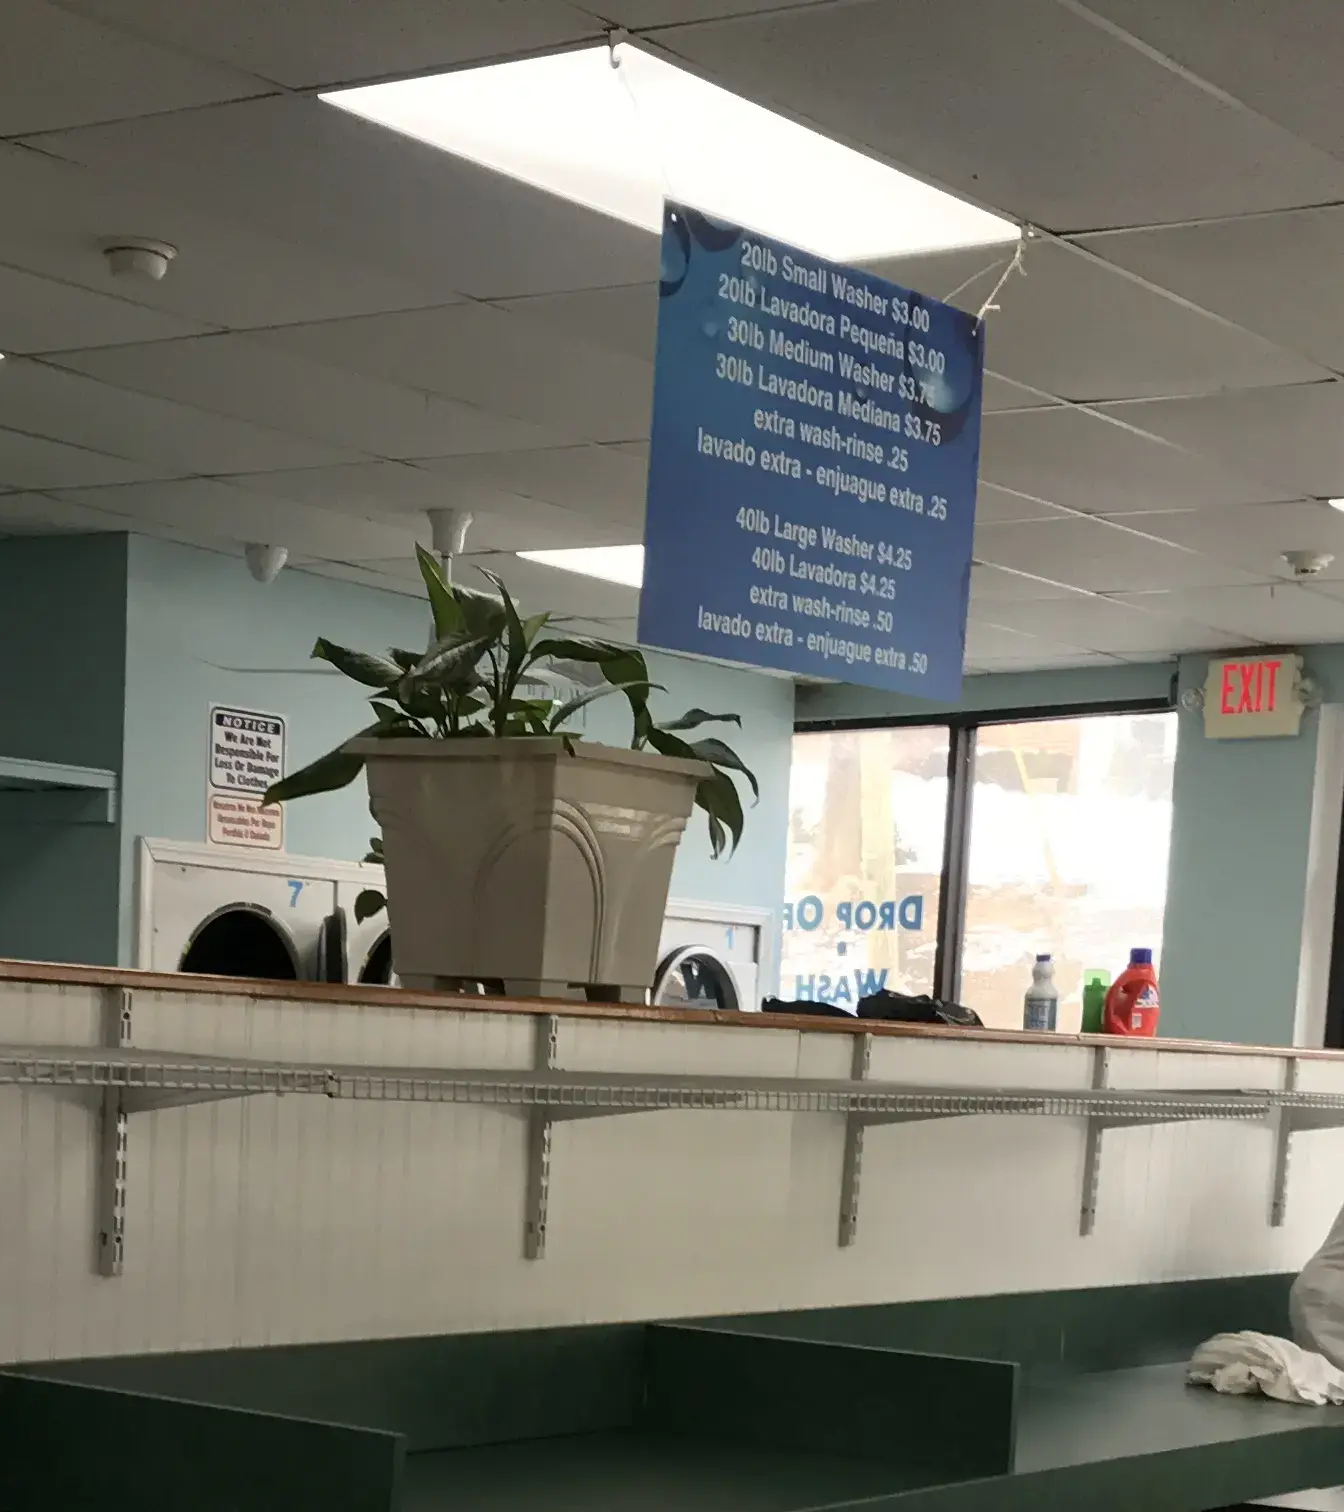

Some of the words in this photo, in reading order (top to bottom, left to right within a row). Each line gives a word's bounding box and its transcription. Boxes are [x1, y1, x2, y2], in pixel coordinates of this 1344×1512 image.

[741, 241, 778, 276] 20lb
[782, 256, 827, 294] Small
[832, 273, 891, 317] Washer
[892, 296, 930, 333] $3.00
[718, 274, 755, 309] 20lb
[760, 285, 835, 336] Lavadora
[840, 317, 904, 364] Pequeña
[908, 342, 945, 374] $3.00
[727, 316, 764, 350] 30lb
[769, 328, 833, 374] Medium
[838, 355, 894, 393] Washer
[716, 353, 754, 386] 30lb
[758, 364, 834, 411] Lavadora
[838, 394, 900, 433] Mediana
[904, 414, 942, 446] $3.75
[753, 408, 794, 439] extra
[800, 421, 884, 466] wash-rinse
[886, 449, 909, 473] .25
[696, 426, 756, 466] lavado
[760, 452, 801, 480] extra
[816, 464, 886, 504] enjuague
[889, 487, 924, 515] extra
[927, 495, 948, 522] .25
[736, 506, 770, 535] 40lb
[774, 514, 817, 549] Large
[821, 525, 874, 562] Washer
[877, 541, 913, 571] $4.25
[751, 546, 785, 576] 40lb
[788, 554, 856, 591] Lavadora
[859, 572, 896, 601] $4.25
[697, 605, 752, 638] lavado
[755, 621, 793, 647] extra
[806, 631, 872, 665] enjuague
[874, 646, 906, 671] extra
[749, 585, 788, 612] extra
[792, 591, 870, 630] wash-rinse
[1220, 660, 1281, 714] EXIT
[222, 715, 276, 733] NOTICE
[224, 731, 238, 744] We
[240, 733, 254, 746] Are
[256, 736, 271, 749] Not
[287, 880, 304, 908] 7
